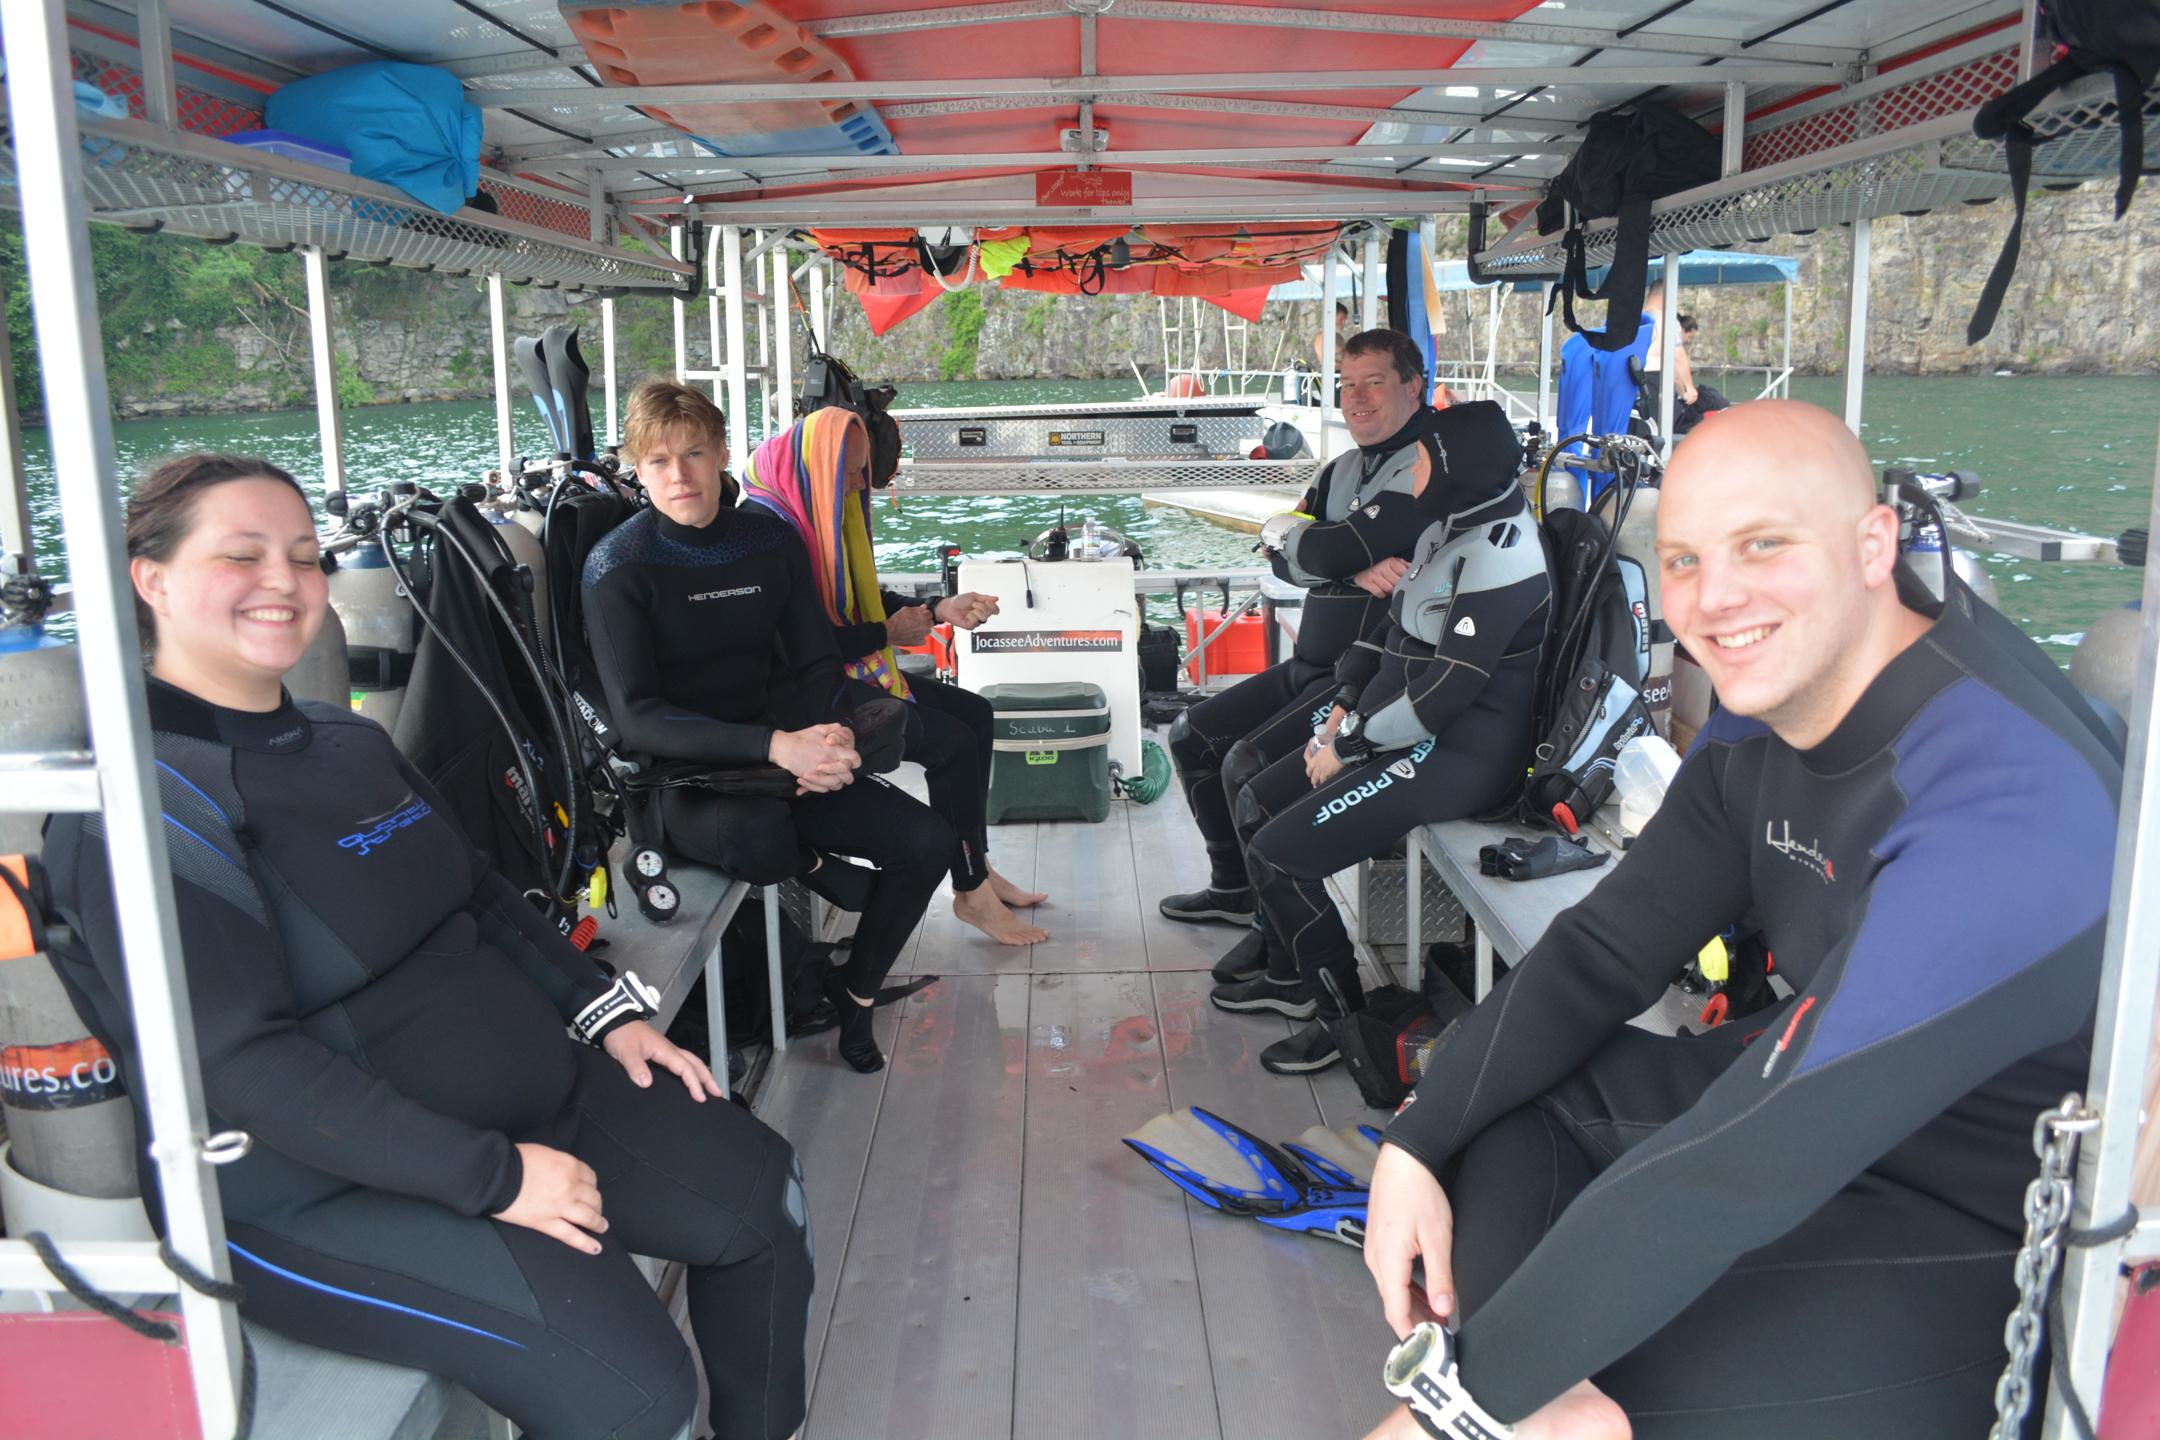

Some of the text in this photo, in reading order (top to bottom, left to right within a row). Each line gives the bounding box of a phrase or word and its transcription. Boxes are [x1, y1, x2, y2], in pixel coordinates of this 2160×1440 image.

[1083, 186, 1094, 200] for
[1095, 187, 1110, 200] tips
[1111, 187, 1130, 200] only
[1061, 432, 1102, 440] NORTHERN
[688, 586, 761, 601] HENDERSON
[1634, 602, 1650, 651] mares
[975, 633, 1118, 651] JocasseeAdventures.com
[1009, 721, 1056, 736] Scuba
[1029, 754, 1055, 762] IGLOO
[1315, 772, 1394, 824] PROOF
